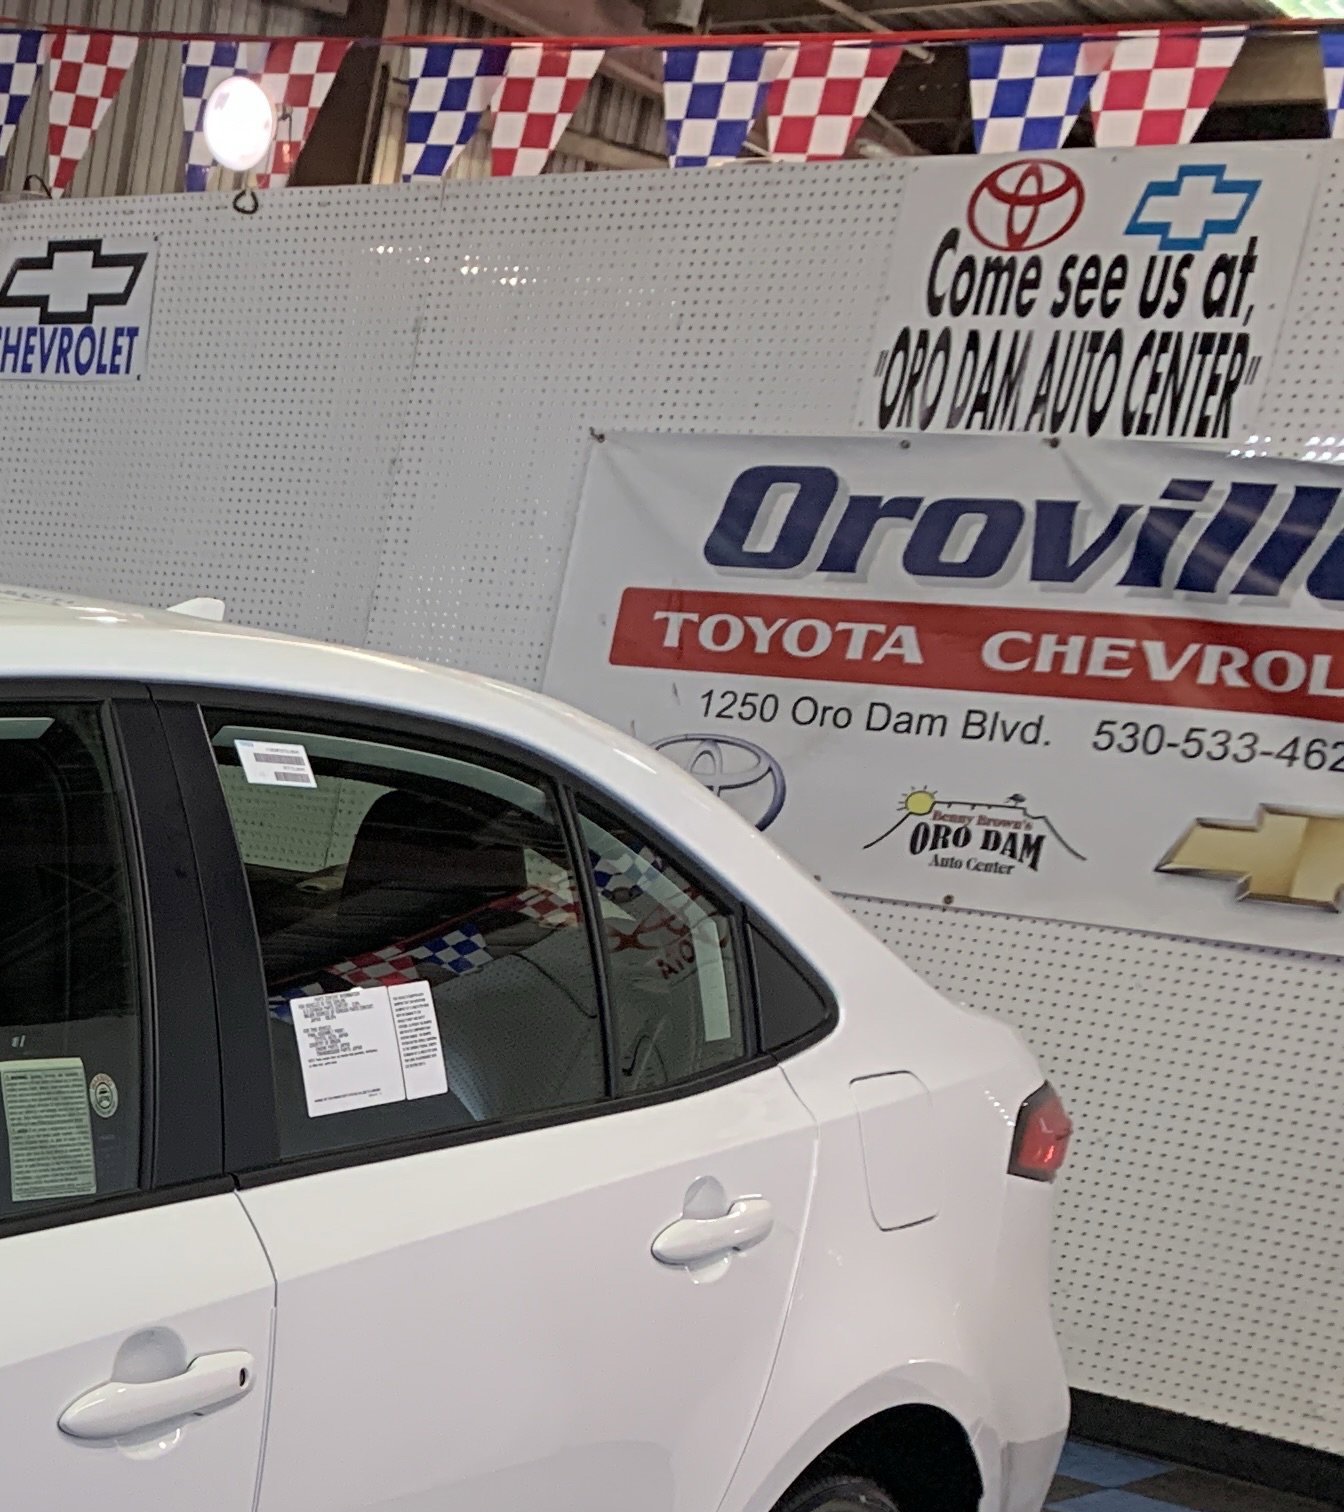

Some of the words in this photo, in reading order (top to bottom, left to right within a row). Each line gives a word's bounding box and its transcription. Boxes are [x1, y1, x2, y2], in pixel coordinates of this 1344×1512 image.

[926, 226, 1043, 318] Come
[1049, 252, 1129, 319] see
[1138, 252, 1196, 319] us
[1202, 235, 1259, 327] at,
[873, 326, 954, 431] "ORO
[946, 327, 1035, 432] DAM
[1023, 327, 1124, 437] AUTO
[1120, 328, 1263, 439] CENTER"
[651, 609, 925, 665] TOYOTA
[699, 688, 779, 724] 1250
[791, 695, 853, 730] Oro
[865, 701, 949, 738] Dam
[961, 708, 1052, 747] Blvd.
[909, 821, 973, 856] ORO
[980, 828, 1048, 872] DAM
[931, 809, 976, 827] Benny
[975, 813, 1034, 832] Brown's
[928, 853, 964, 870] Auto
[965, 856, 1016, 876] Center
